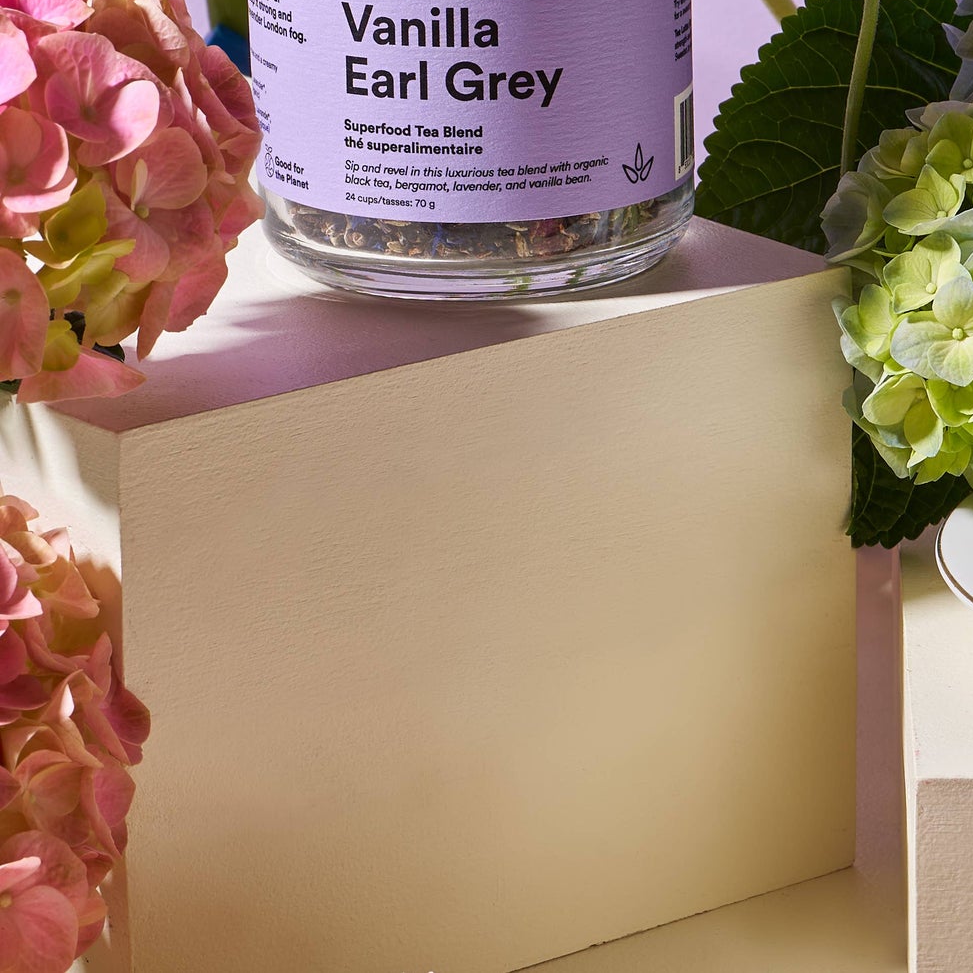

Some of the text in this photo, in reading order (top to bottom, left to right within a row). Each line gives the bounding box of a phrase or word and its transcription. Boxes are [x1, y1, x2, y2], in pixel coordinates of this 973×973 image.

[259, 1, 277, 20] strong
[278, 11, 292, 23] and
[264, 16, 288, 37] London
[289, 27, 307, 44] fog.
[341, 2, 499, 48] Vanilla
[345, 55, 564, 108] Earl Grey
[344, 118, 483, 138] Superfood Tea Blend
[344, 136, 483, 155] thé superalimentaire
[275, 156, 304, 175] Good for
[345, 155, 609, 178] Sip and revel in this luxurious tea blend with organic
[275, 170, 309, 190] the Planet
[345, 174, 592, 193] black tea, bergamot, lavender, and vanilla bean.
[345, 192, 435, 209] 24 cups/tasses: 70 g
